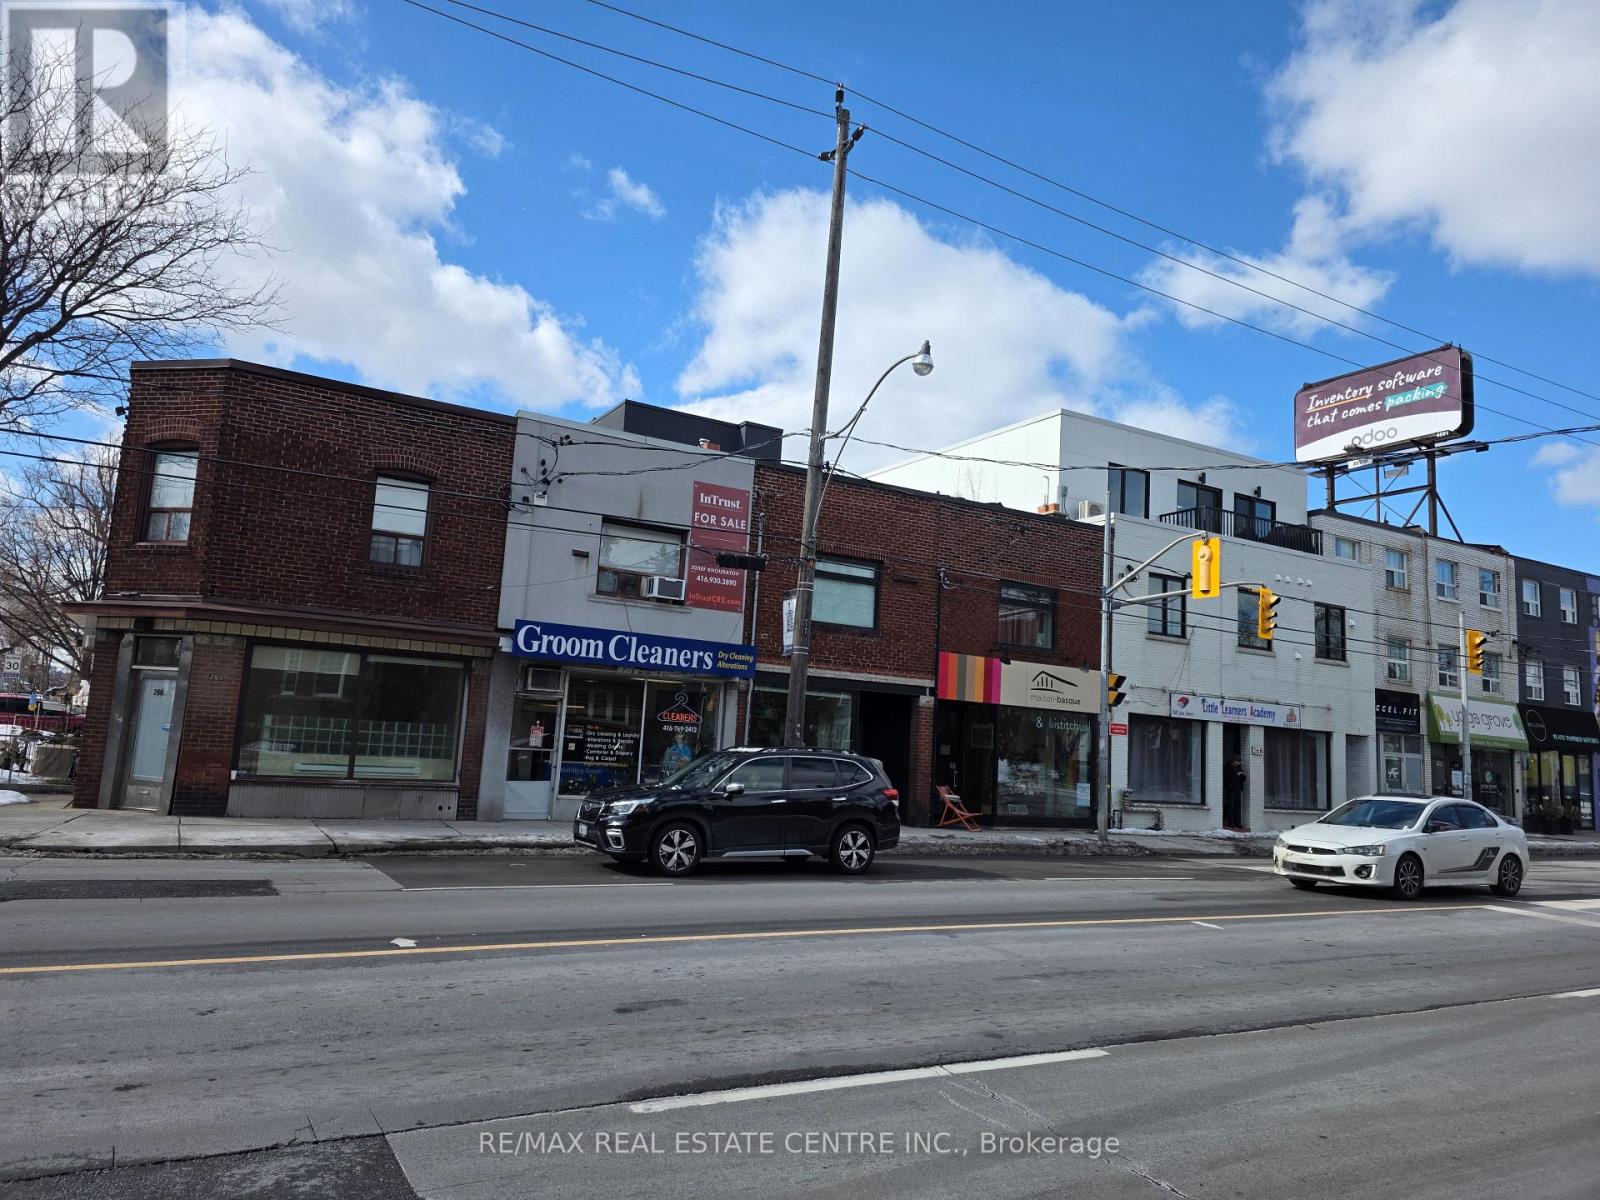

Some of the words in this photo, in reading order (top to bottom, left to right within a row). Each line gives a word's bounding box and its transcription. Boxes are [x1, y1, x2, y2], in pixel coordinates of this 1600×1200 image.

[1307, 384, 1373, 411] Inventory
[1378, 366, 1442, 391] software
[1307, 408, 1338, 427] that
[1342, 400, 1382, 419] comes
[1386, 384, 1444, 411] packing
[1351, 427, 1398, 446] odoo
[700, 493, 741, 509] InTrust
[694, 512, 716, 525] FOR
[721, 516, 746, 530] SALE
[517, 624, 603, 659] Groom
[608, 634, 713, 670] Cleaners
[718, 651, 729, 660] Dry
[729, 652, 754, 662] Cleaning
[6, 662, 19, 670] 30
[717, 662, 749, 671] Alterations
[663, 712, 698, 723] CLEANERS
[1221, 702, 1247, 716] Learners
[1250, 705, 1276, 720] Academy
